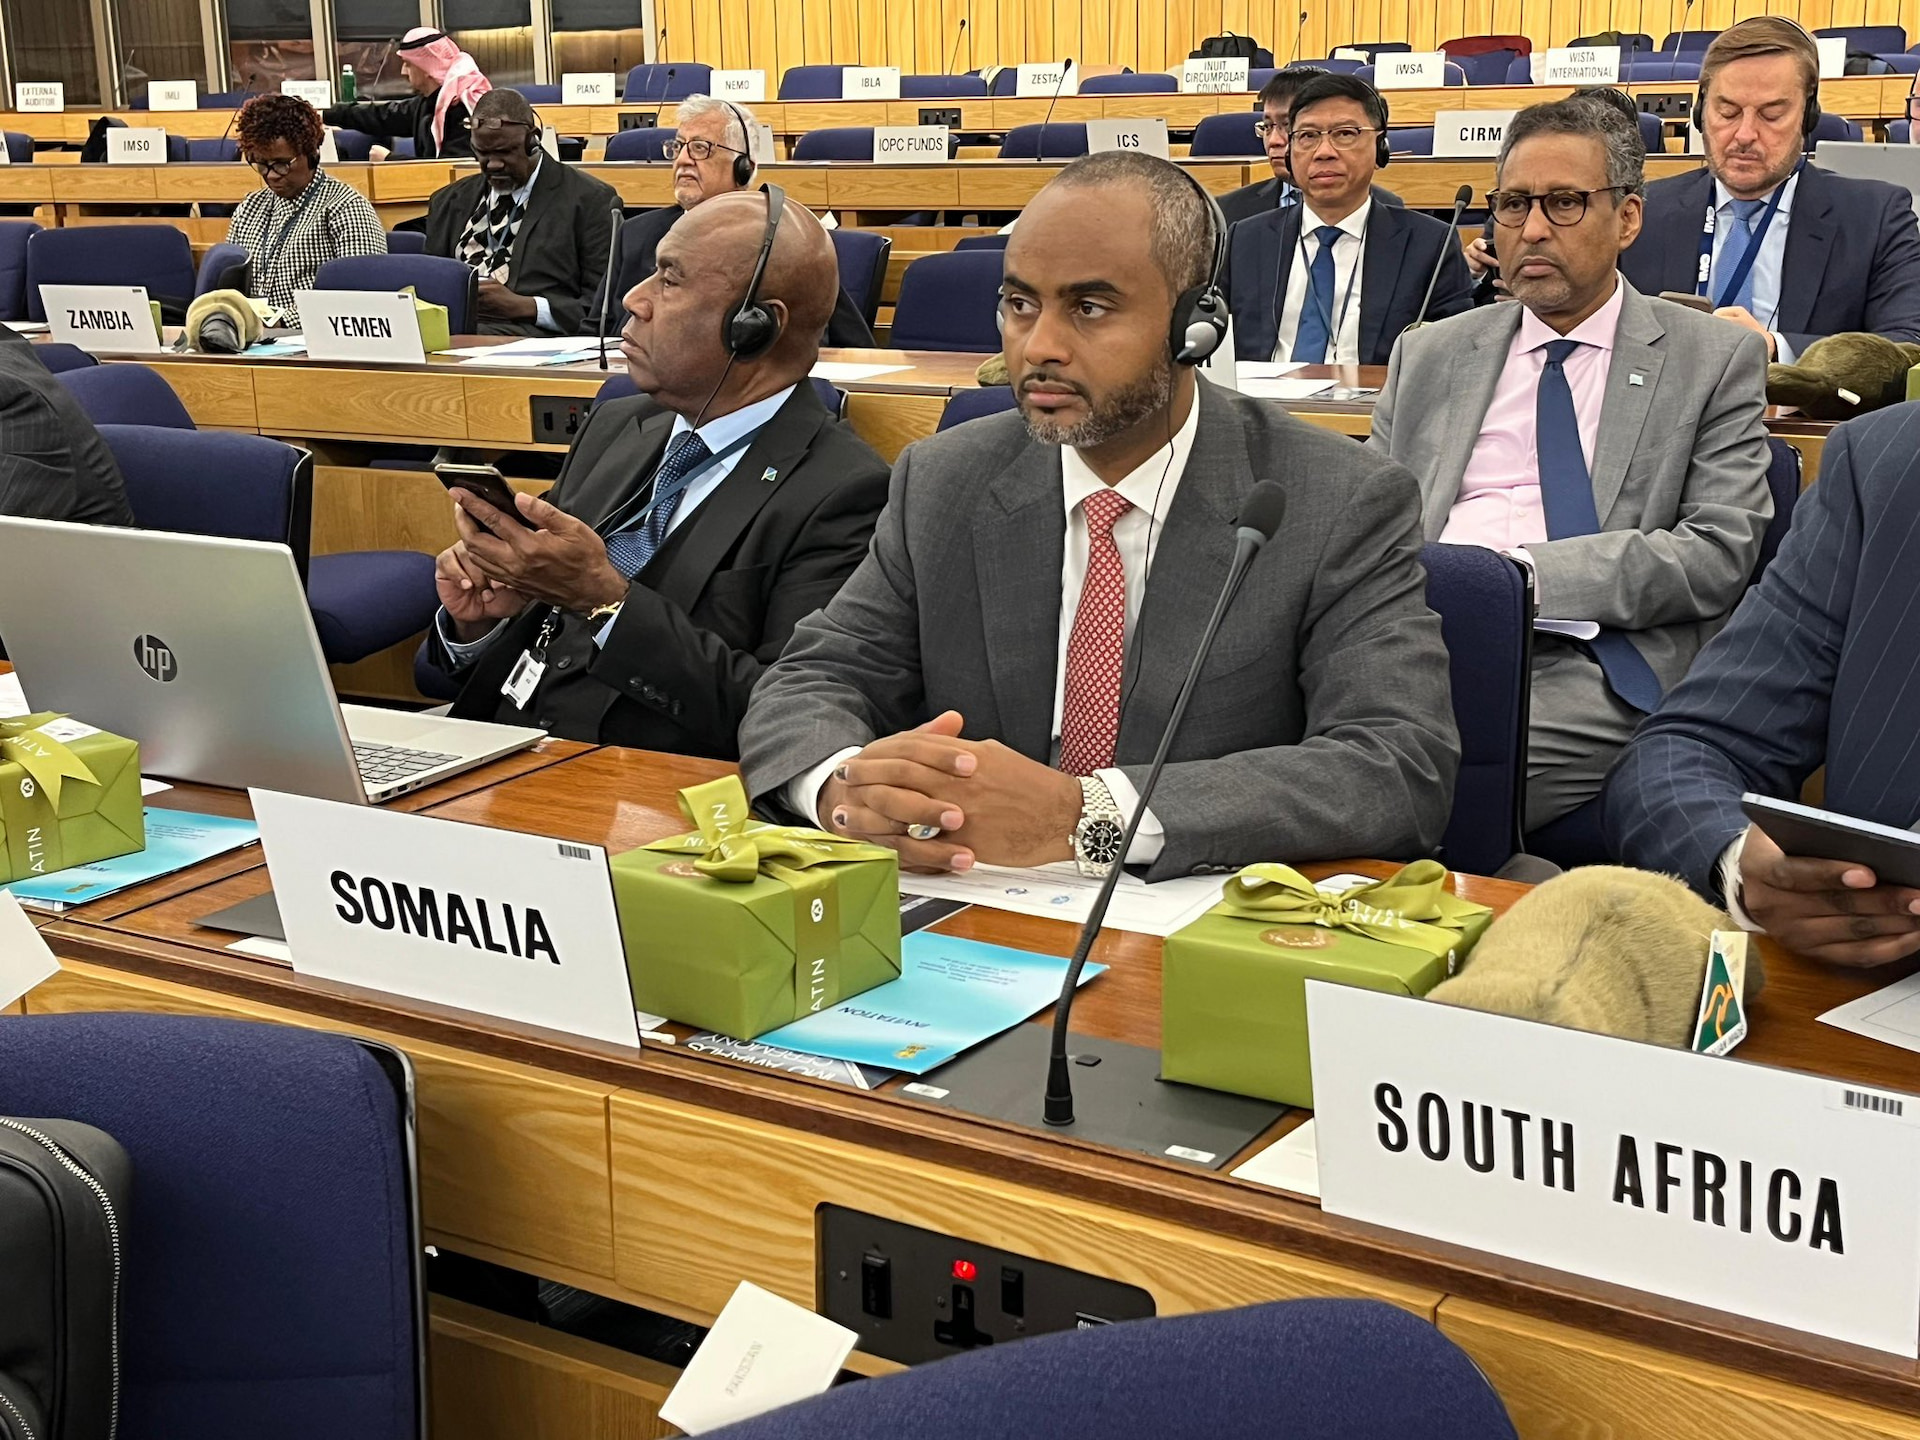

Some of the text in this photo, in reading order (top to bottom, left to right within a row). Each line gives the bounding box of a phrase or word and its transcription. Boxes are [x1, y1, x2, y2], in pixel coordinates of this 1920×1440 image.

[1569, 51, 1596, 63] WISTA
[1204, 60, 1227, 71] INUIT
[1395, 63, 1424, 75] IWSA
[1185, 71, 1246, 83] CIRCUMPOLAR
[1549, 67, 1614, 79] INTERNATIONAL
[725, 80, 750, 90] NEMO
[861, 77, 881, 88] IBLA
[1196, 83, 1233, 93] COUNCIL
[22, 87, 57, 97] EXTERNAL
[576, 84, 601, 94] PIANC
[25, 97, 56, 106] AUDITOR
[1459, 127, 1502, 142] CIRM
[123, 140, 150, 152] IMSO
[878, 137, 944, 152] IOPC FUNDS
[1116, 134, 1140, 148] ICS
[66, 309, 134, 331] ZAMBIA
[328, 314, 392, 339] YEMEN
[141, 633, 171, 682] hp
[330, 869, 560, 966] SOMALIA
[1374, 1081, 1845, 1255] SOUTH AFRICA
